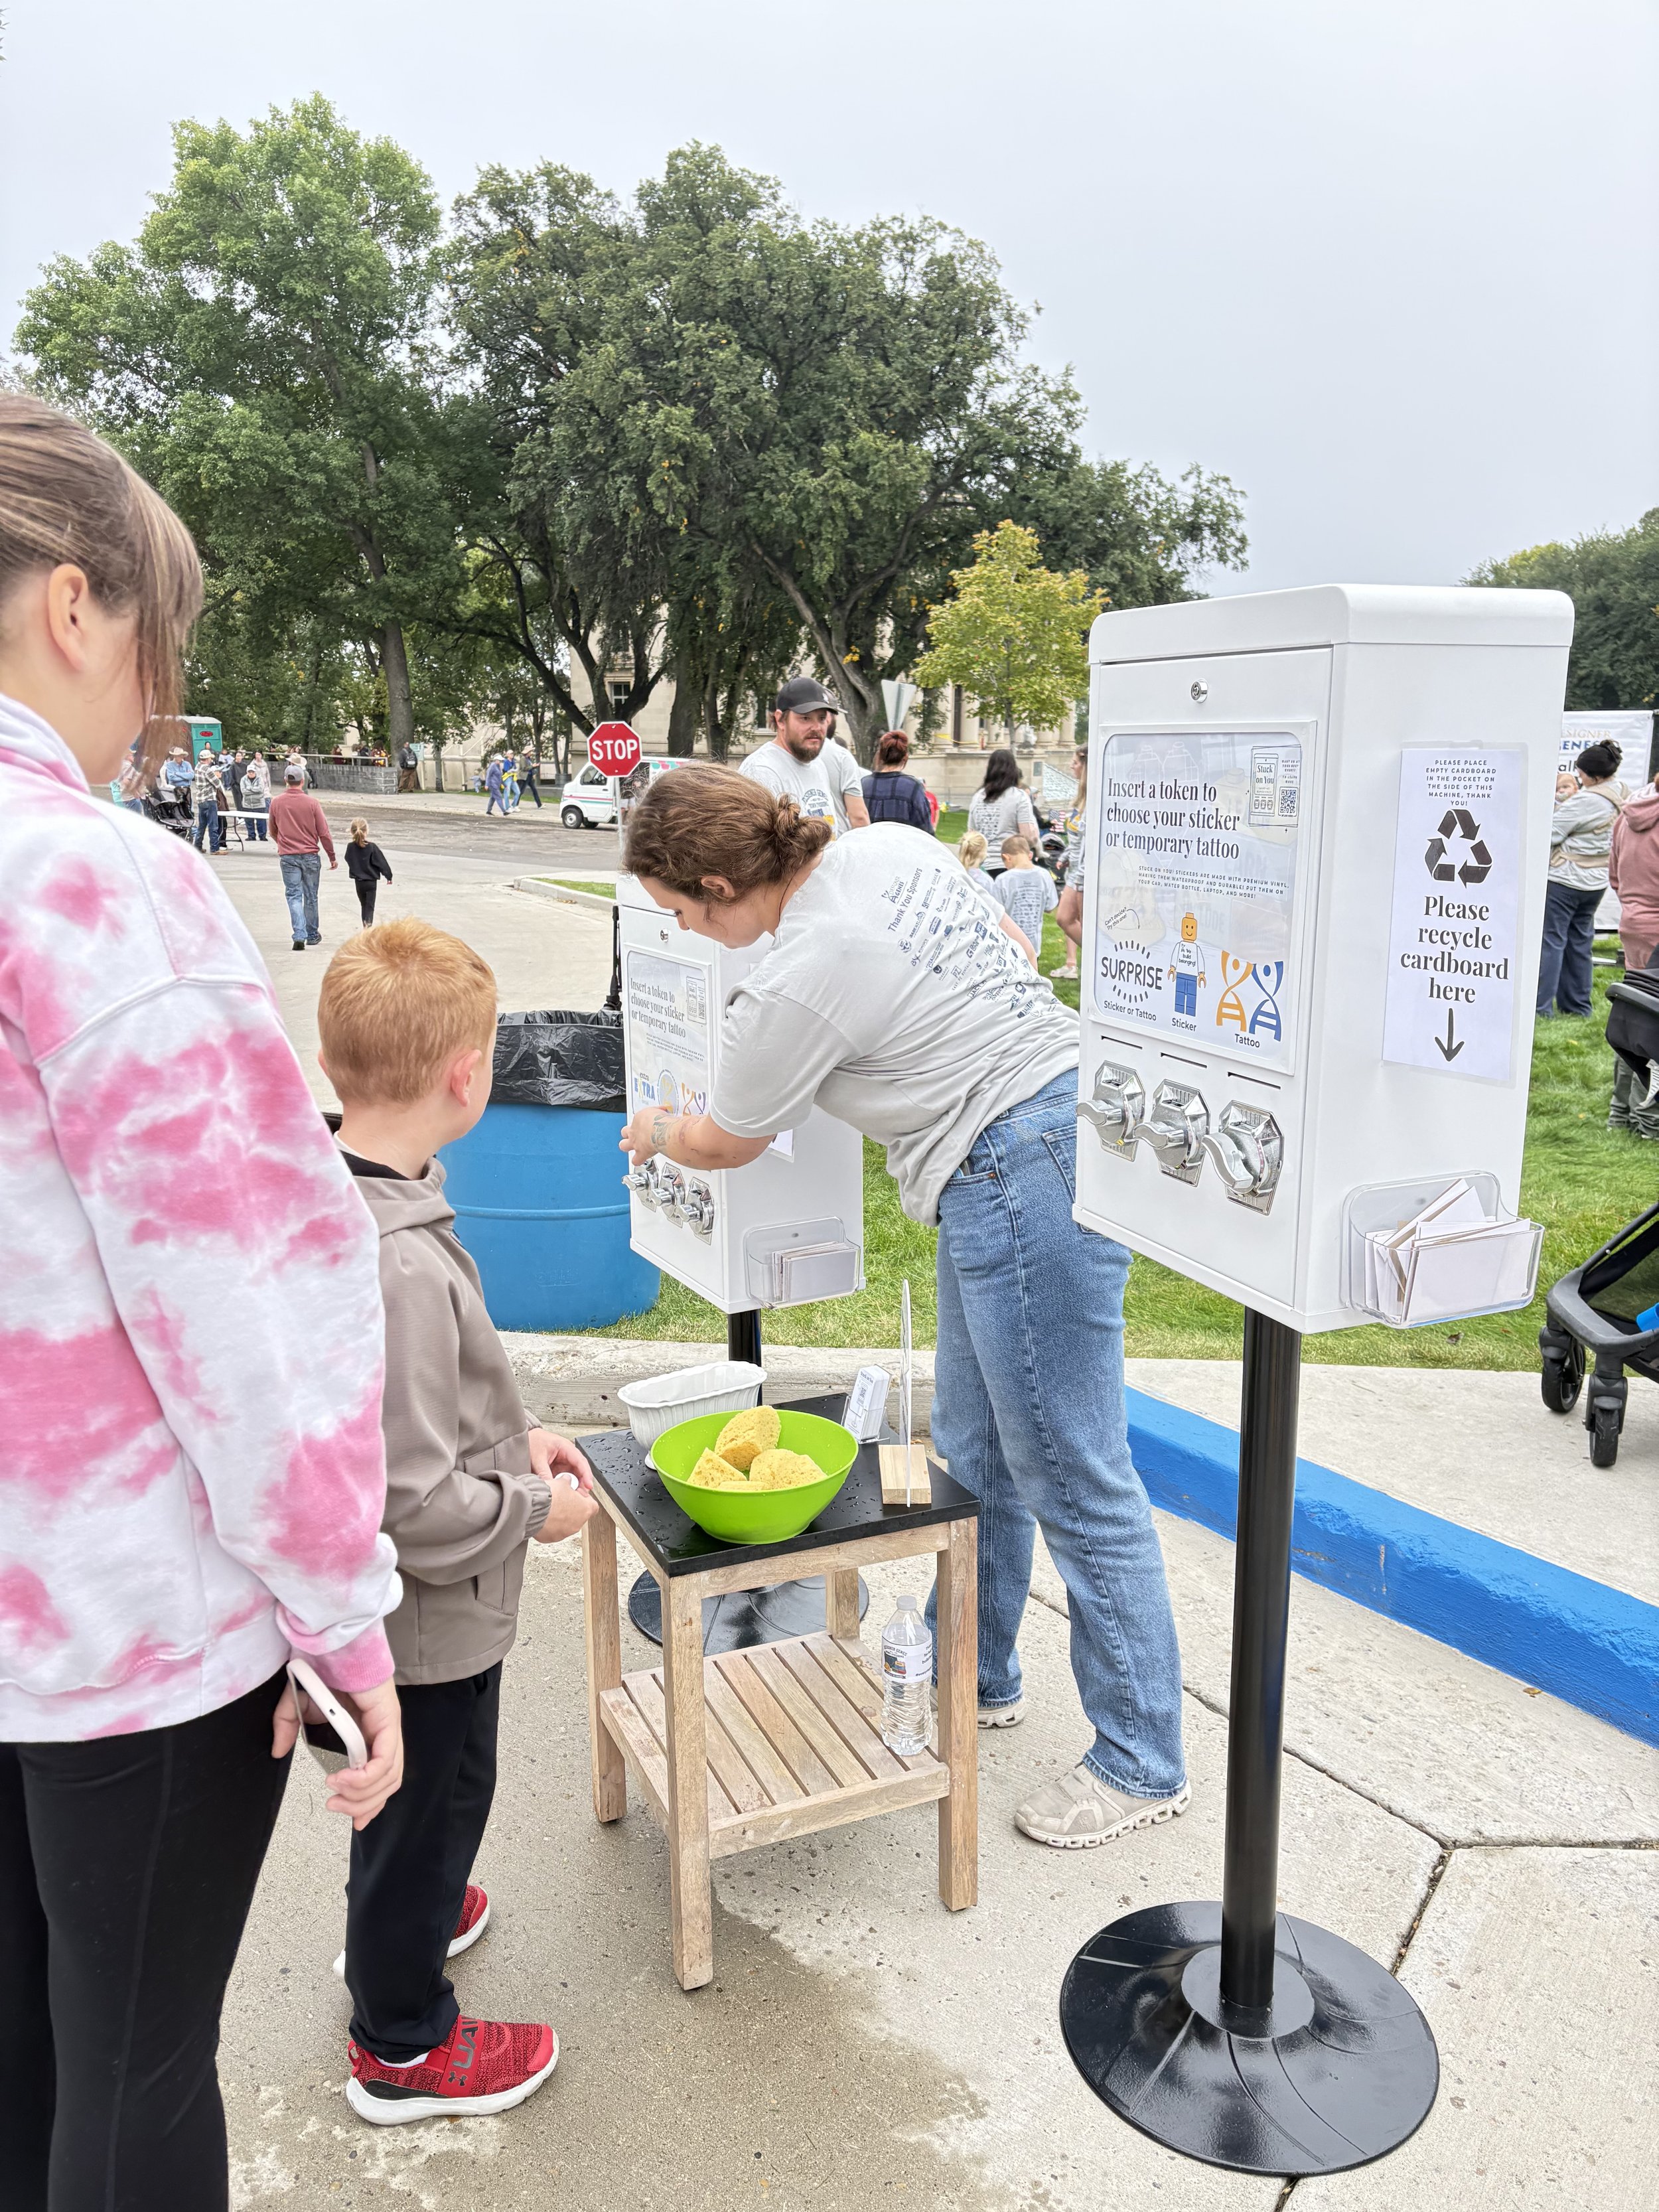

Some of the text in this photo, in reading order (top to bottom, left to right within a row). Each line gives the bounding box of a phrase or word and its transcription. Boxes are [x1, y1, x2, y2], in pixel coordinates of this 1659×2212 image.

[592, 739, 638, 761] STOP
[1257, 765, 1273, 773] Stuck
[1108, 778, 1216, 802] Insert a token to
[1107, 802, 1240, 831] choose your sticker
[1106, 831, 1240, 859] or temporary tattoo
[1172, 876, 1204, 885] WATERPROOF
[888, 867, 922, 932] Thank You Sponsors
[1424, 895, 1490, 921] Please
[1417, 927, 1492, 950] recycle
[1101, 956, 1163, 990] SURPRISE
[1400, 950, 1509, 980] cardboard
[630, 978, 646, 994] Insert
[648, 986, 651, 995] a
[652, 986, 668, 1001] token
[669, 992, 675, 1003] to
[1429, 976, 1476, 1003] here
[631, 993, 685, 1022] choose your sticker
[1104, 1000, 1125, 1013] Sticker
[1135, 1008, 1157, 1021] Tattoo
[631, 1009, 686, 1037] or temporary tattoo
[1172, 1017, 1196, 1031] Sticker
[1234, 1033, 1260, 1048] Tattoo
[634, 1077, 656, 1100] EXTRA
